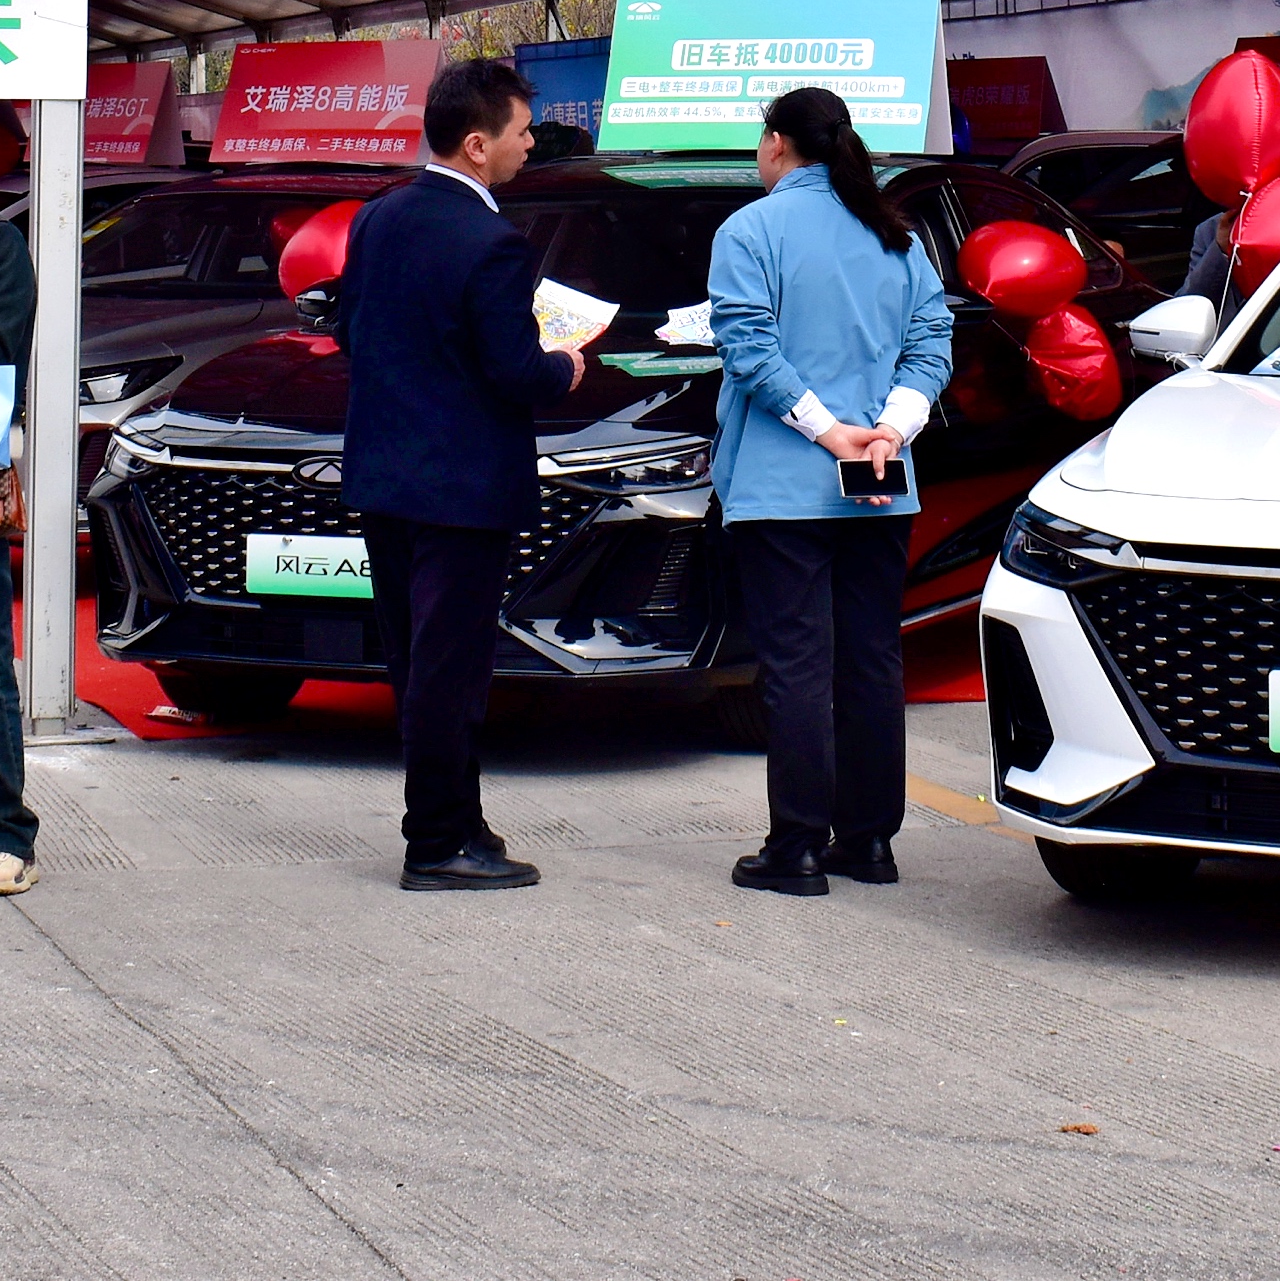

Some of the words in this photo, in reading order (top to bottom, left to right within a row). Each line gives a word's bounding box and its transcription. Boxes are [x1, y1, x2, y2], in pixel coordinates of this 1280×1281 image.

[240, 84, 410, 114] 艾瑞泽8高能版
